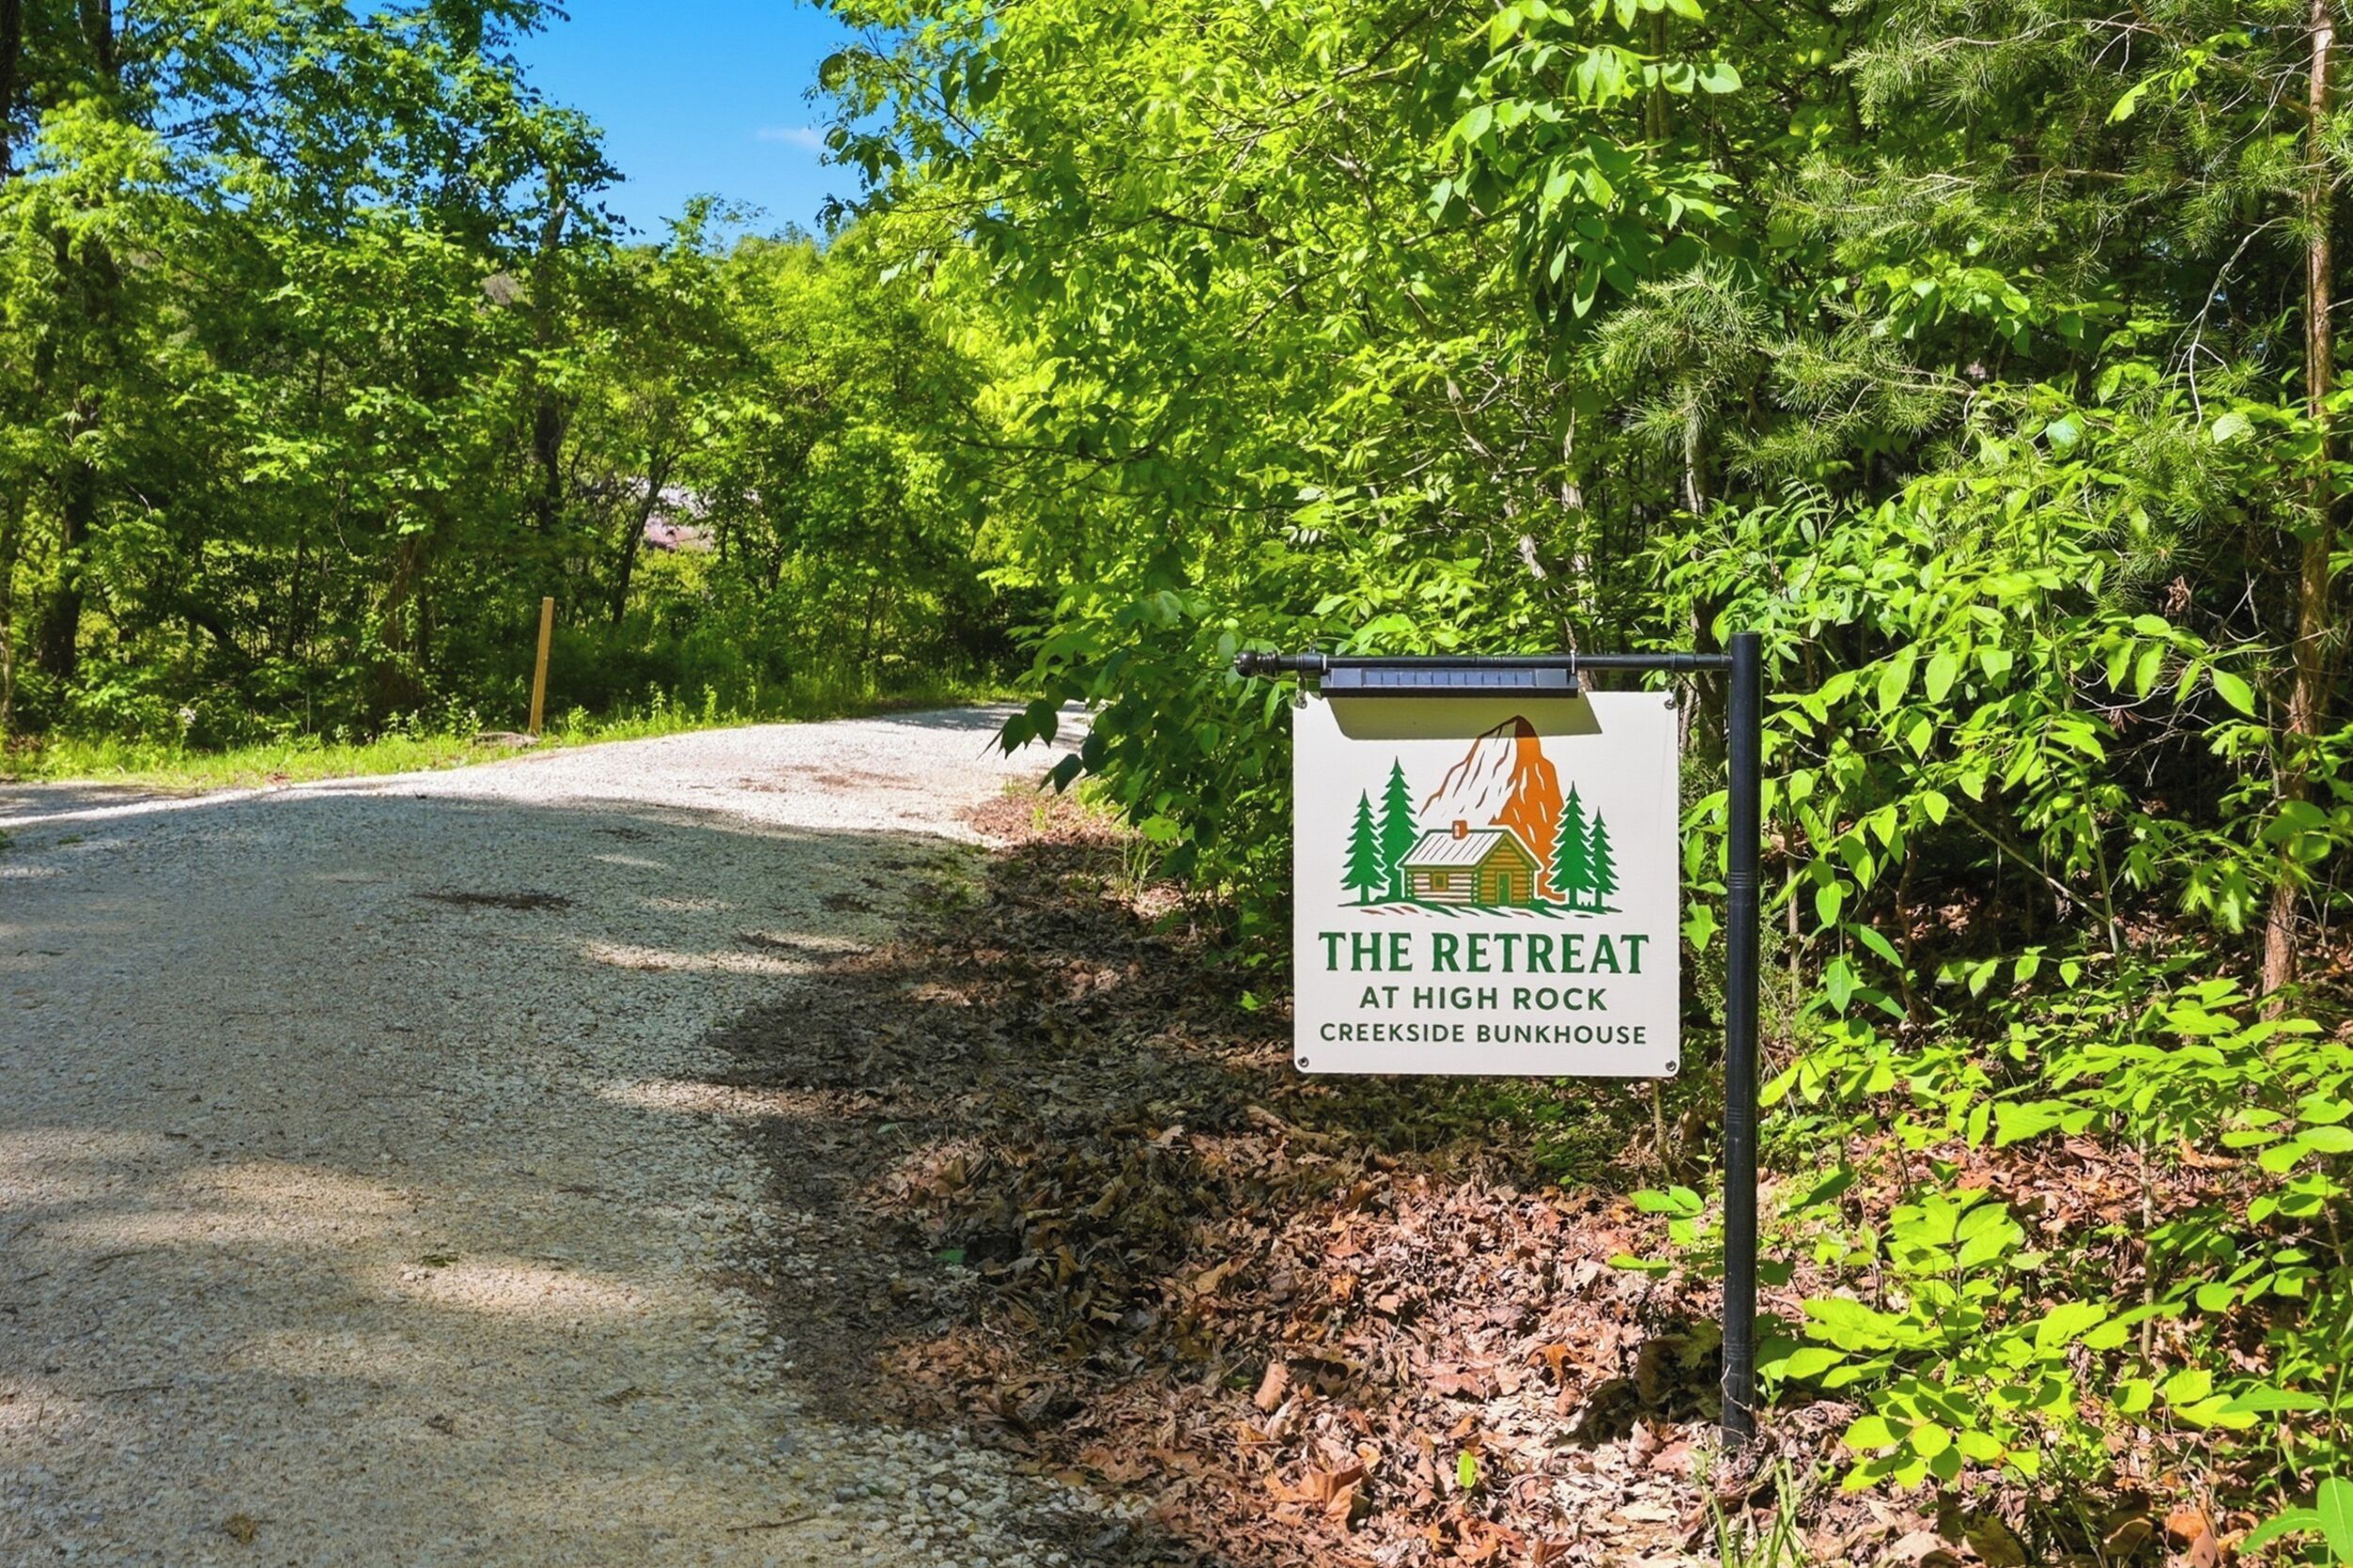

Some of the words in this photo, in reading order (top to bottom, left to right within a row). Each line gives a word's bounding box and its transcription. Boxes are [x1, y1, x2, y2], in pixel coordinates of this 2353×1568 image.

[1318, 931, 1413, 972] THE
[1431, 932, 1650, 974] RETREAT
[1359, 985, 1400, 1009] AT
[1413, 986, 1497, 1010] HIGH
[1513, 987, 1608, 1011] ROCK
[1320, 1022, 1465, 1043] CREEKSIDE
[1477, 1024, 1646, 1045] BUNKHOUSE
